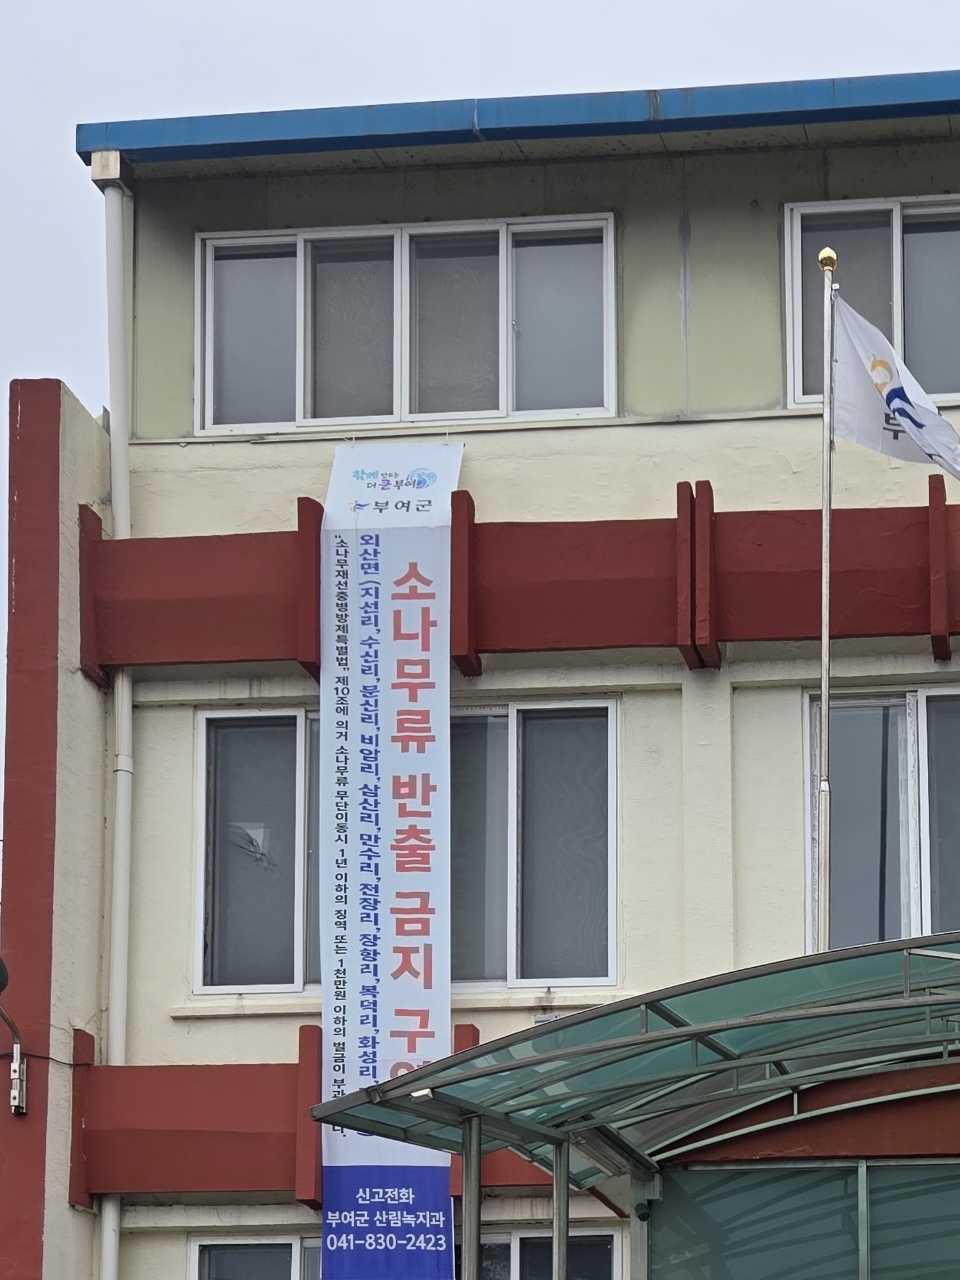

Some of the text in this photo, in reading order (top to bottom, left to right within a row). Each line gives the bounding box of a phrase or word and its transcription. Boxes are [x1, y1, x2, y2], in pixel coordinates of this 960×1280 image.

[352, 469, 400, 480] 함께 만드는
[366, 479, 416, 491] 더 큰 부여
[373, 499, 432, 513] 부여군
[358, 533, 381, 575] 외산면
[390, 561, 437, 754] 소나무류
[333, 676, 350, 716] 제10조에
[335, 720, 349, 742] 의거
[335, 745, 349, 787] 소나무류
[390, 773, 437, 873] 반출
[335, 848, 349, 869] 1년
[335, 872, 349, 905] 이하의
[334, 909, 348, 931] 징역
[333, 934, 348, 955] 또는
[390, 891, 435, 990] 금지
[333, 958, 347, 1001] 1천만원
[333, 1004, 347, 1038] 이하의
[332, 1041, 346, 1075] 벌금이
[355, 1187, 415, 1205] 신고전화
[326, 1210, 446, 1228] 부여군 산림녹지과
[326, 1233, 447, 1251] 041-830-2423
